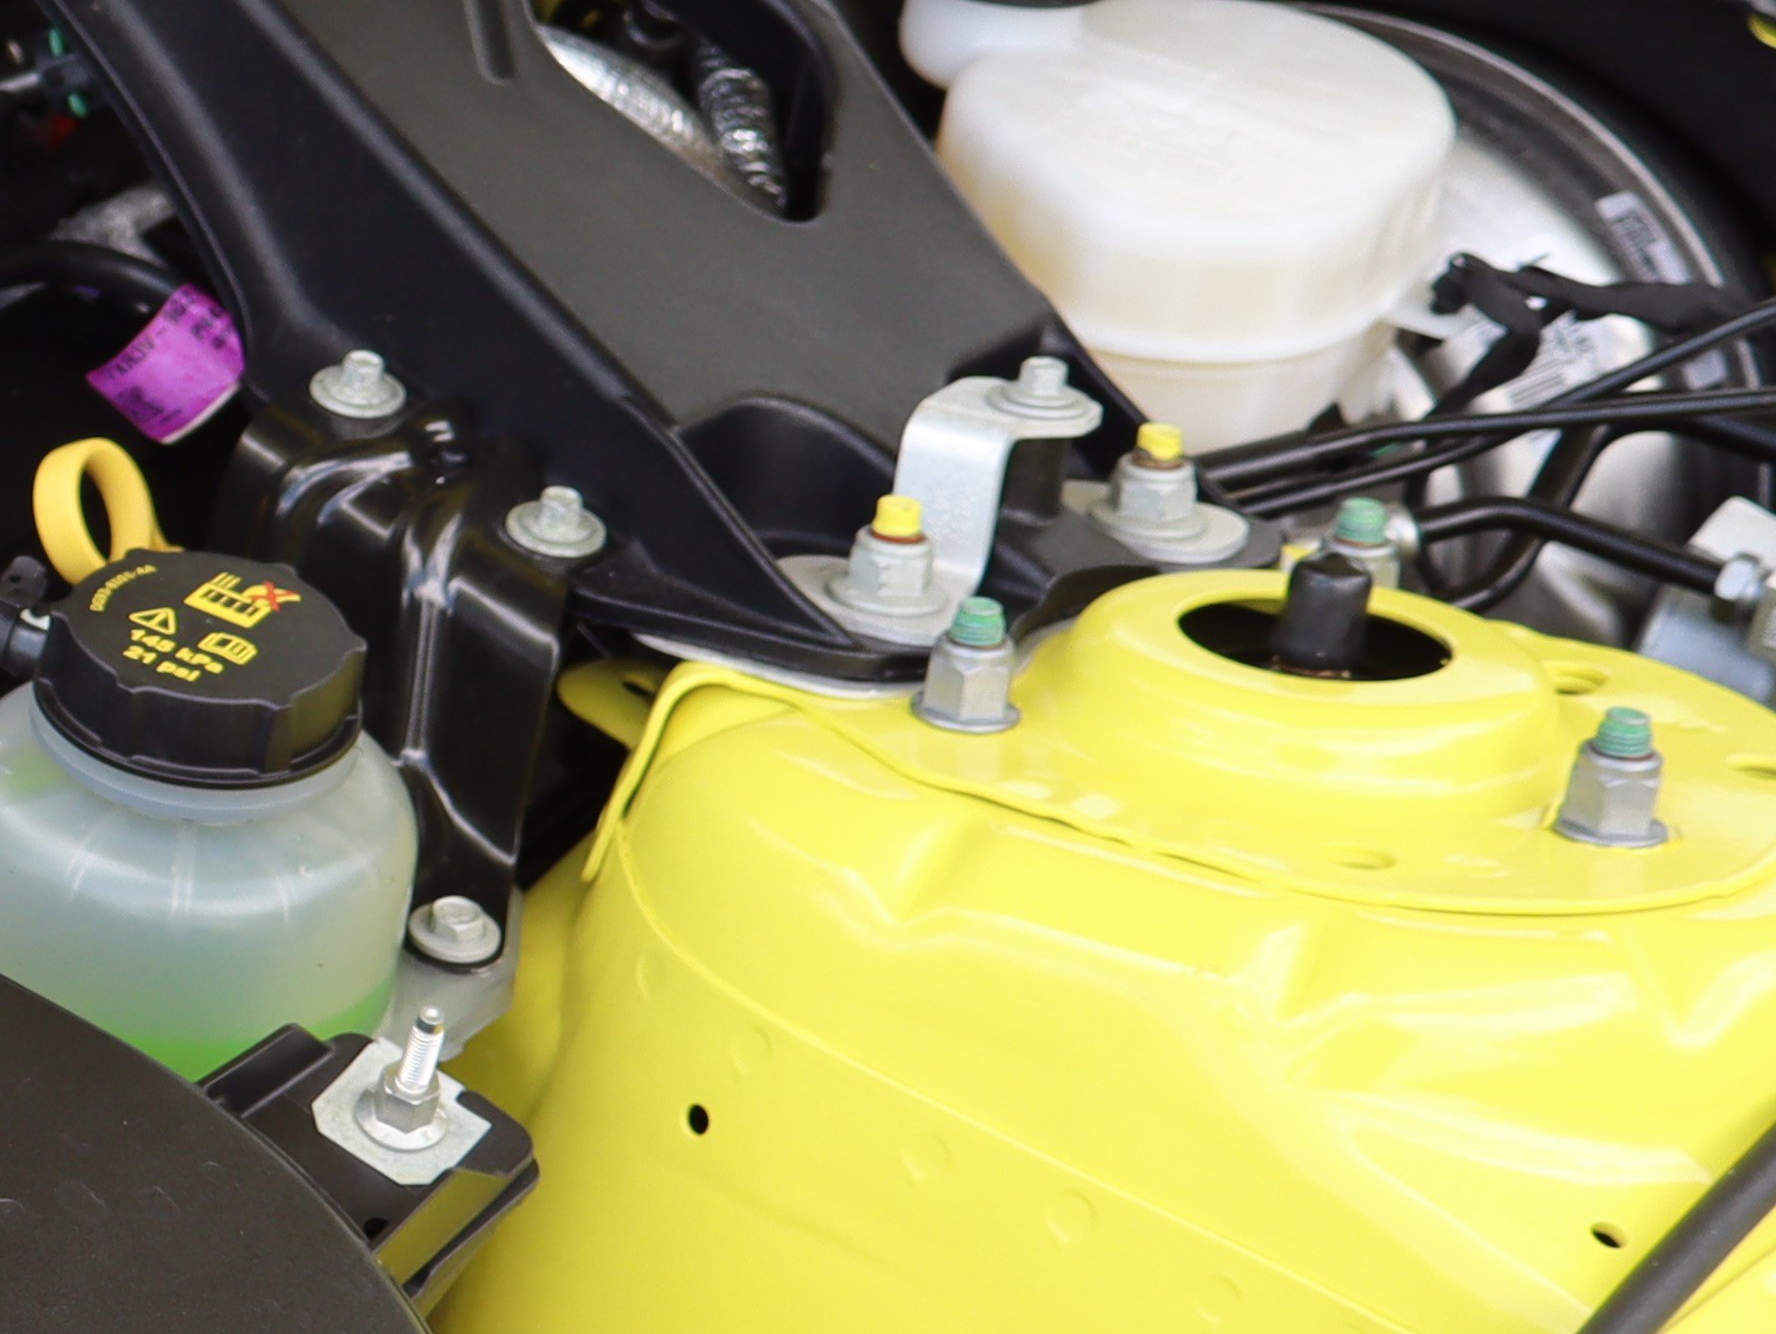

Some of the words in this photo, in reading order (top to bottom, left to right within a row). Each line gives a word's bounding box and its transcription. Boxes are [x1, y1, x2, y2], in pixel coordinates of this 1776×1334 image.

[122, 645, 158, 666] 21
[155, 658, 202, 683] psi
[129, 627, 177, 657] 145
[175, 646, 225, 675] kPa
